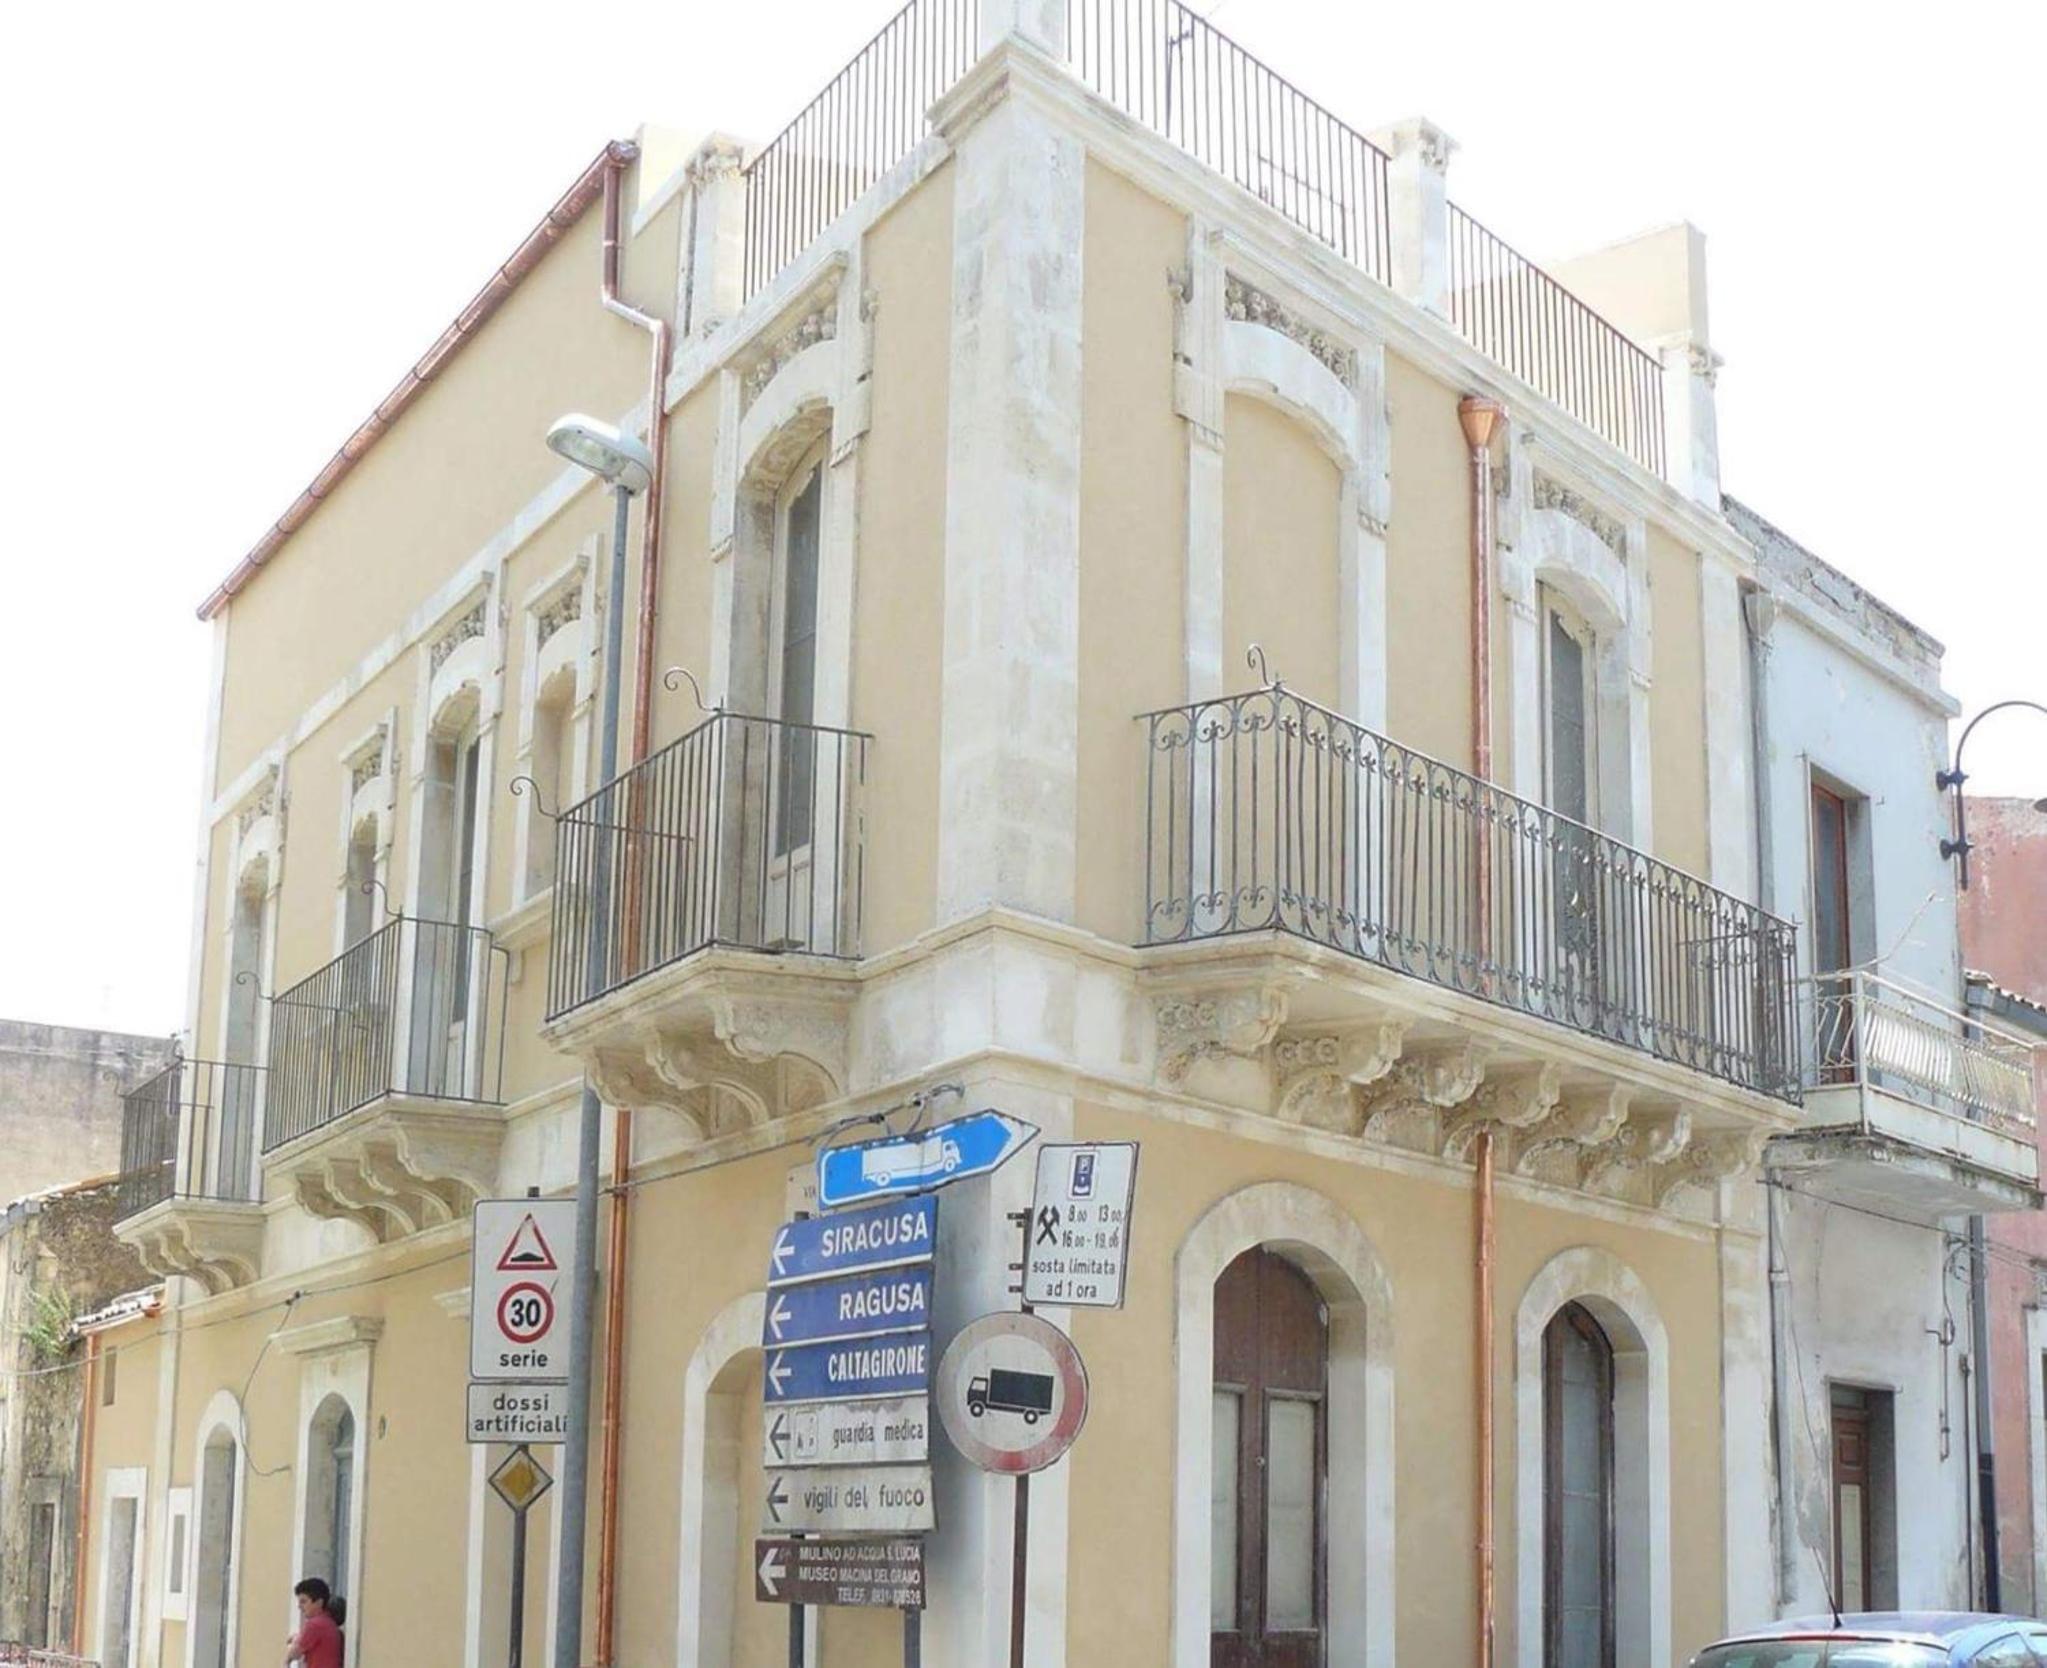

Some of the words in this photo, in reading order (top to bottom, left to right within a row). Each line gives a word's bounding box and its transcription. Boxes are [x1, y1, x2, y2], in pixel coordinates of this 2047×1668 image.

[821, 1211, 929, 1258] SIRACUSA
[1032, 1258, 1065, 1274] sosta
[1069, 1257, 1116, 1275] limitata
[1046, 1280, 1063, 1297] ad
[1067, 1280, 1073, 1297] 1
[1076, 1283, 1098, 1298] ora
[839, 1282, 925, 1321] RAGUSA
[510, 1298, 541, 1327] 30
[499, 1349, 548, 1367] serie
[828, 1344, 926, 1383] CALTAGIRONE
[492, 1393, 549, 1411] dossi
[474, 1414, 568, 1433] artificiali
[833, 1420, 875, 1449] guardia
[885, 1418, 924, 1442] medica
[804, 1486, 838, 1514] vigili
[844, 1485, 869, 1509] del
[879, 1484, 925, 1508] fuoco
[800, 1546, 841, 1561] MULINO
[799, 1565, 838, 1582] MUSEO
